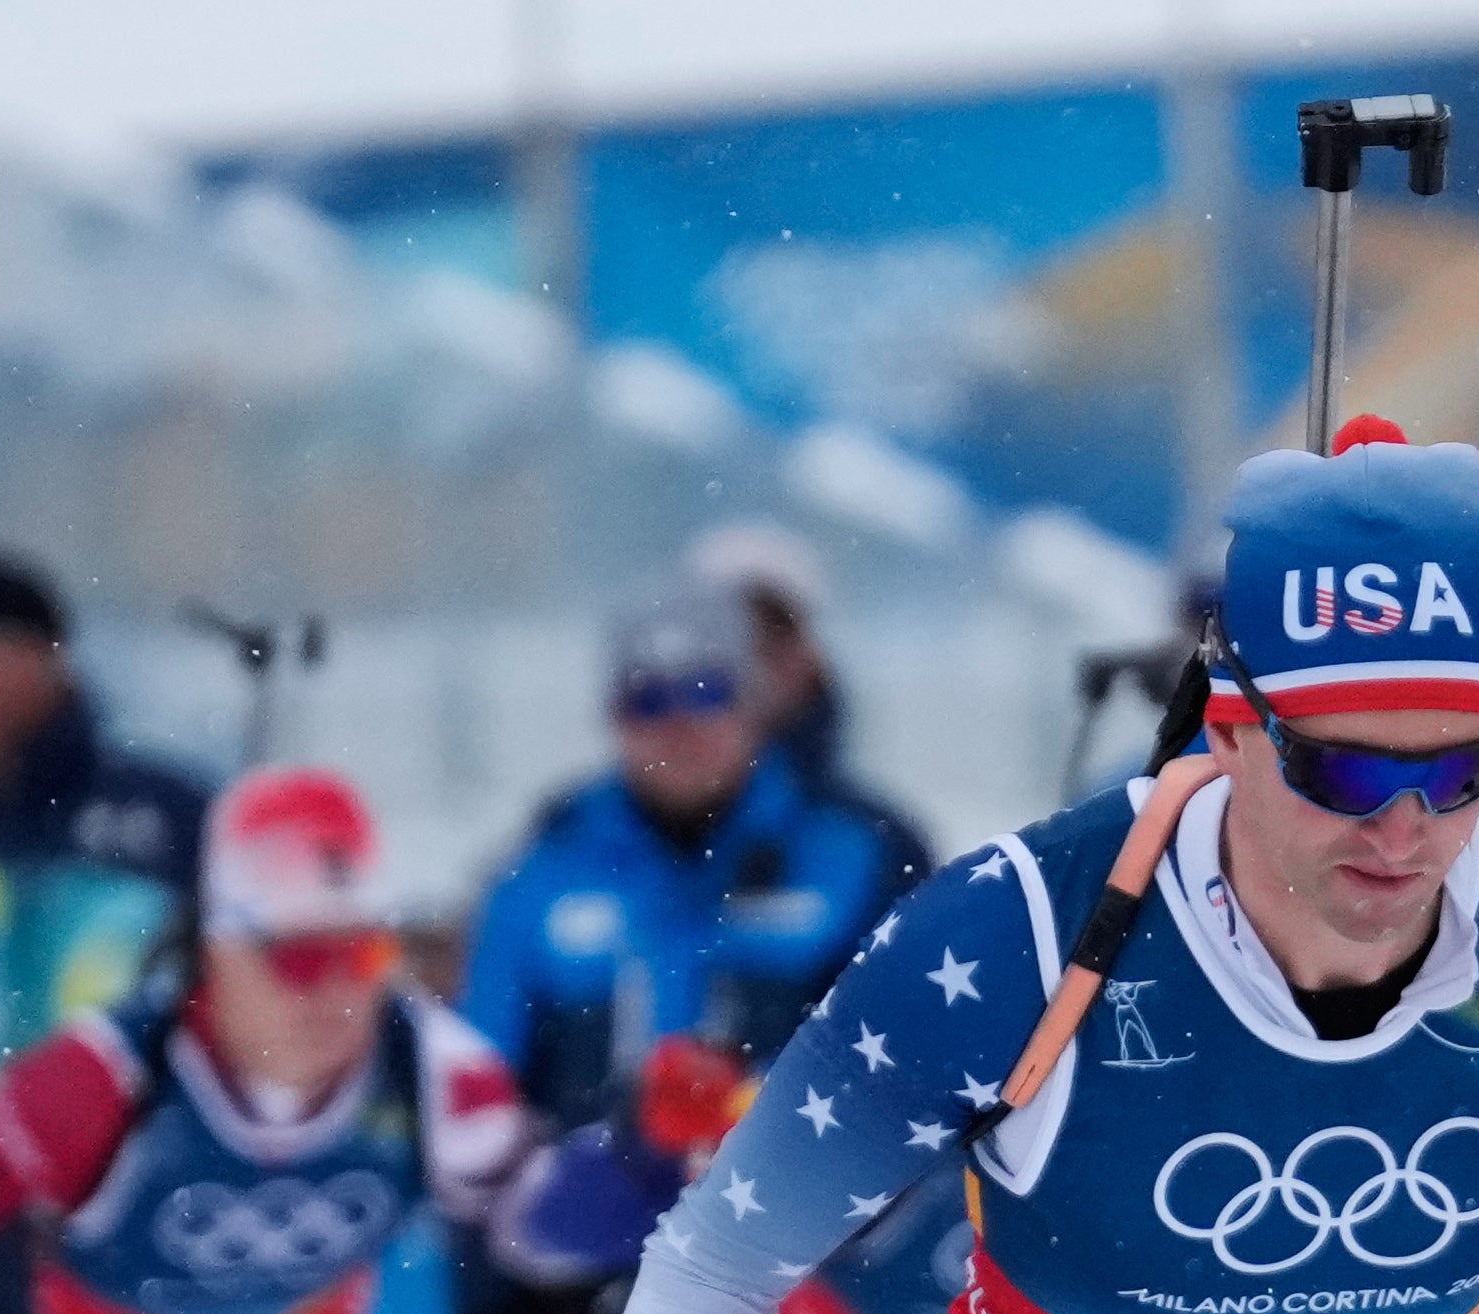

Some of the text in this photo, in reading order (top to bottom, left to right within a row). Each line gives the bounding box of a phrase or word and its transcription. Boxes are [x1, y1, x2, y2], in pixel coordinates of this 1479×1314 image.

[1281, 561, 1475, 643] USA
[1117, 1287, 1274, 1314] MILANO
[1281, 1285, 1439, 1313] CORTINA
